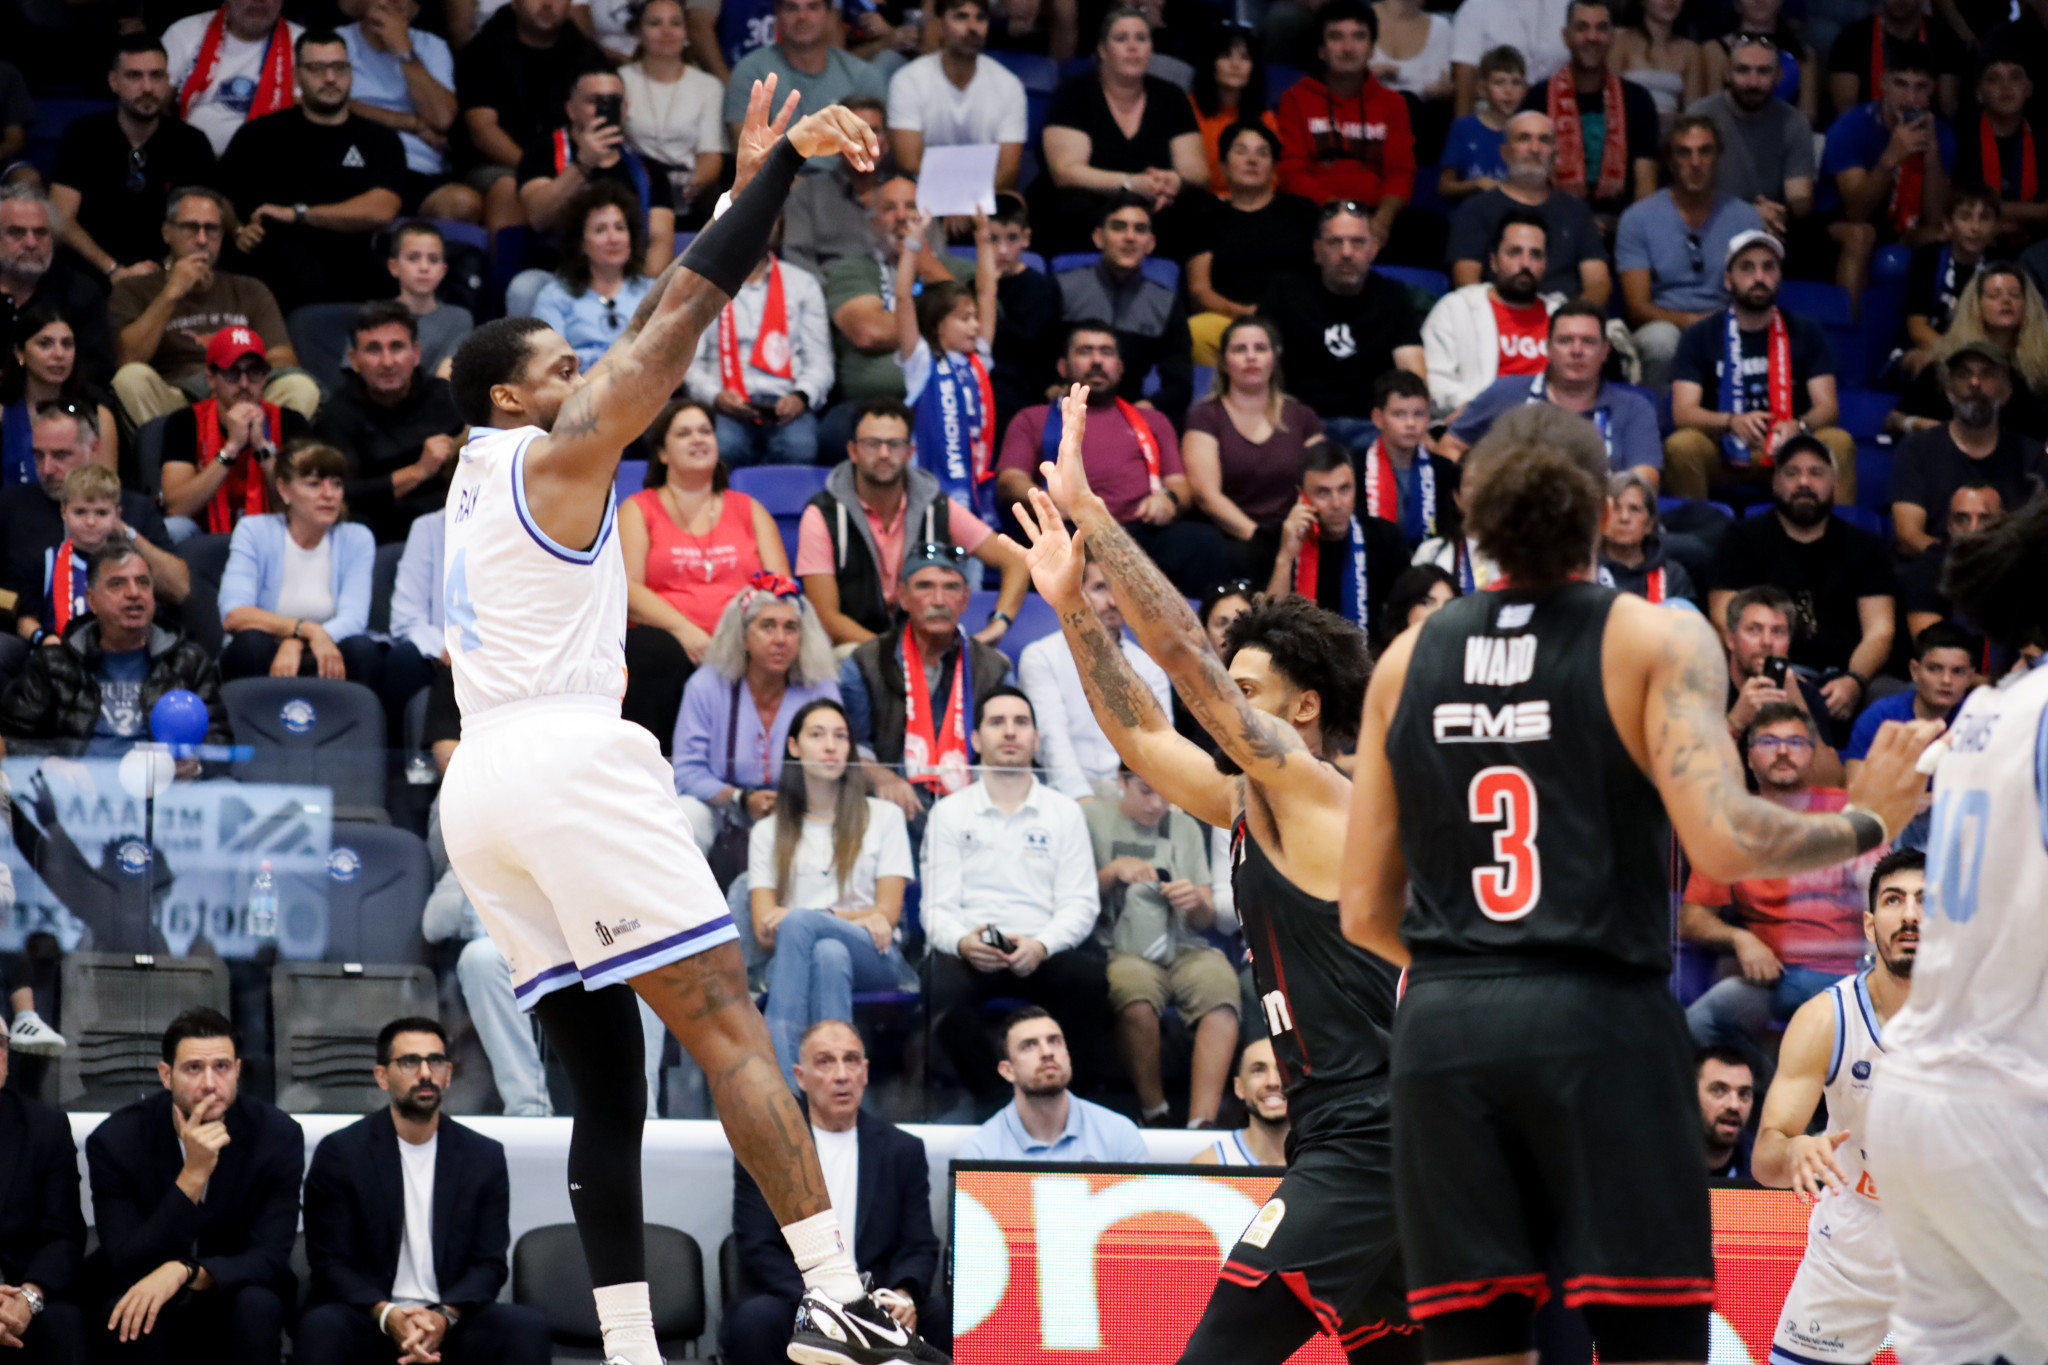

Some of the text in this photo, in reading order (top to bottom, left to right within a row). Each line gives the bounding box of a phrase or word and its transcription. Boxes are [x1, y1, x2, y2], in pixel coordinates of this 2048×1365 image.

[455, 483, 481, 524] RAY
[445, 547, 484, 653] 4
[1433, 701, 1551, 739] FMS
[1468, 766, 1541, 921] 3
